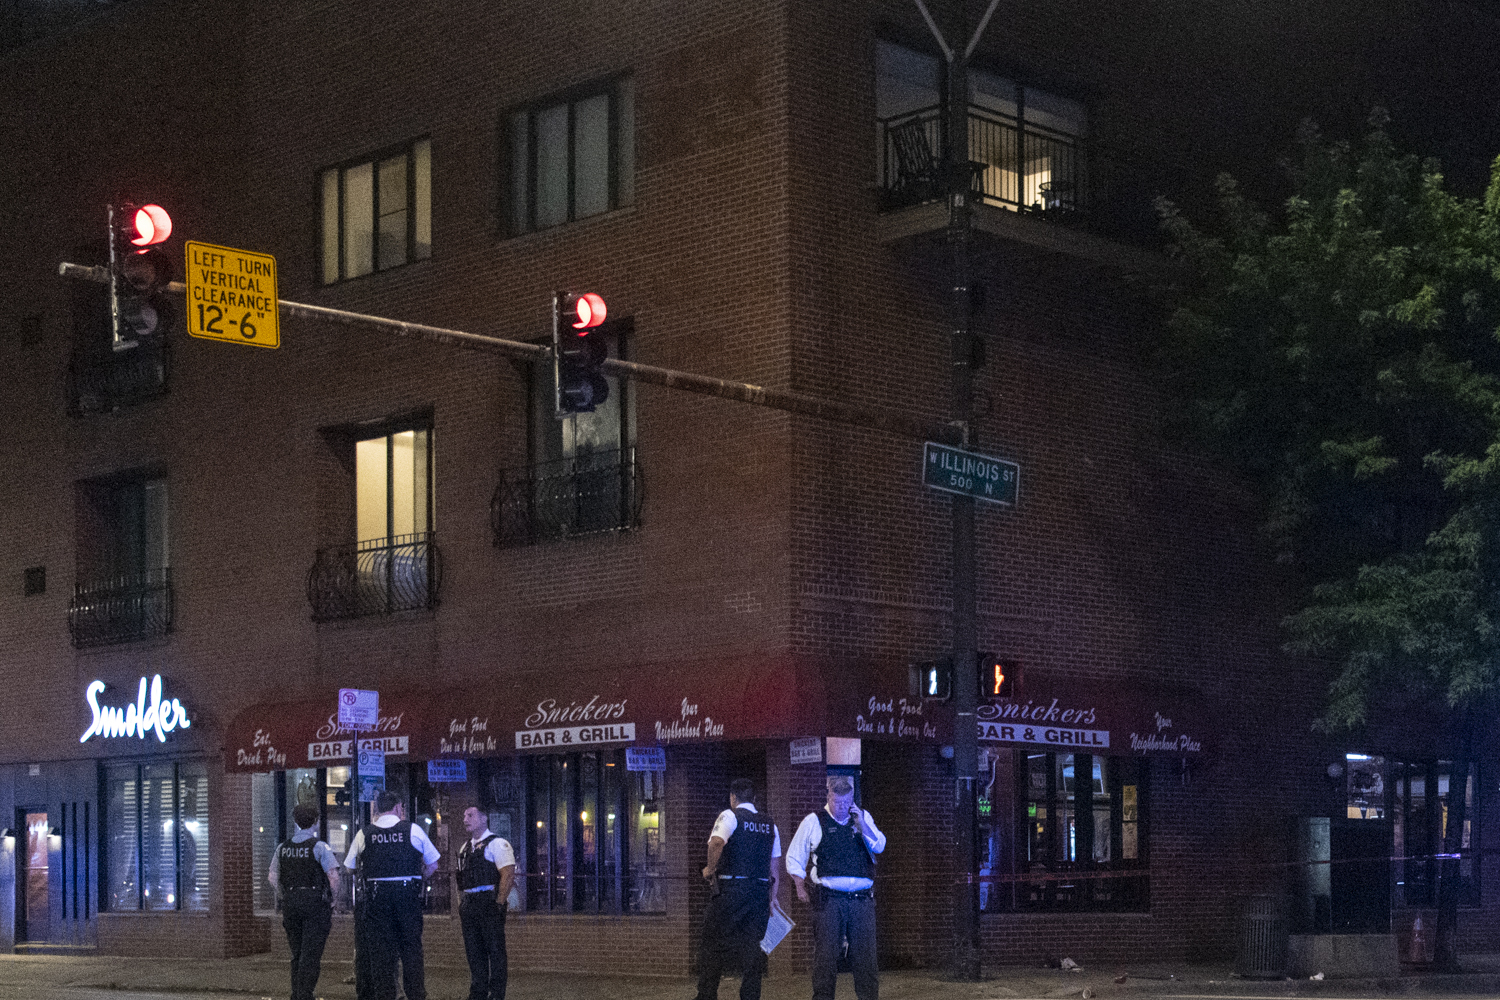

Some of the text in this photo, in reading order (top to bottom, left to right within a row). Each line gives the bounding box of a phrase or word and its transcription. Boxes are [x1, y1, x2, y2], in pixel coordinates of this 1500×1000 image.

[194, 250, 271, 277] LEFT TURN
[201, 269, 264, 294] VERTICAL
[193, 286, 272, 312] CLEARANCE
[929, 451, 1015, 483] W ILLINOIS ST
[950, 474, 994, 495] 500 N
[80, 673, 192, 743] Smolder
[525, 694, 628, 728] Snickers
[681, 696, 699, 721] Your
[867, 695, 923, 716] Good Food
[976, 698, 1096, 725] Snickers
[450, 716, 489, 738] Good Food
[655, 716, 725, 744] Neighborhood Place
[856, 714, 874, 734] Dine
[897, 718, 920, 740] Carry
[923, 721, 937, 739] Out
[1154, 711, 1173, 732] Your
[440, 737, 453, 754] Dine
[469, 736, 485, 755] Carry
[487, 735, 497, 751] Out
[521, 725, 630, 747] BAR & GRILL
[1022, 727, 1037, 742] &
[1044, 729, 1104, 746] GRILL
[1129, 732, 1202, 756] Neighborhood Place
[266, 746, 287, 768] Play
[313, 743, 342, 758] BAR
[371, 832, 404, 844] POLICE
[744, 821, 771, 834] POLICE
[281, 847, 310, 858] POLICE
